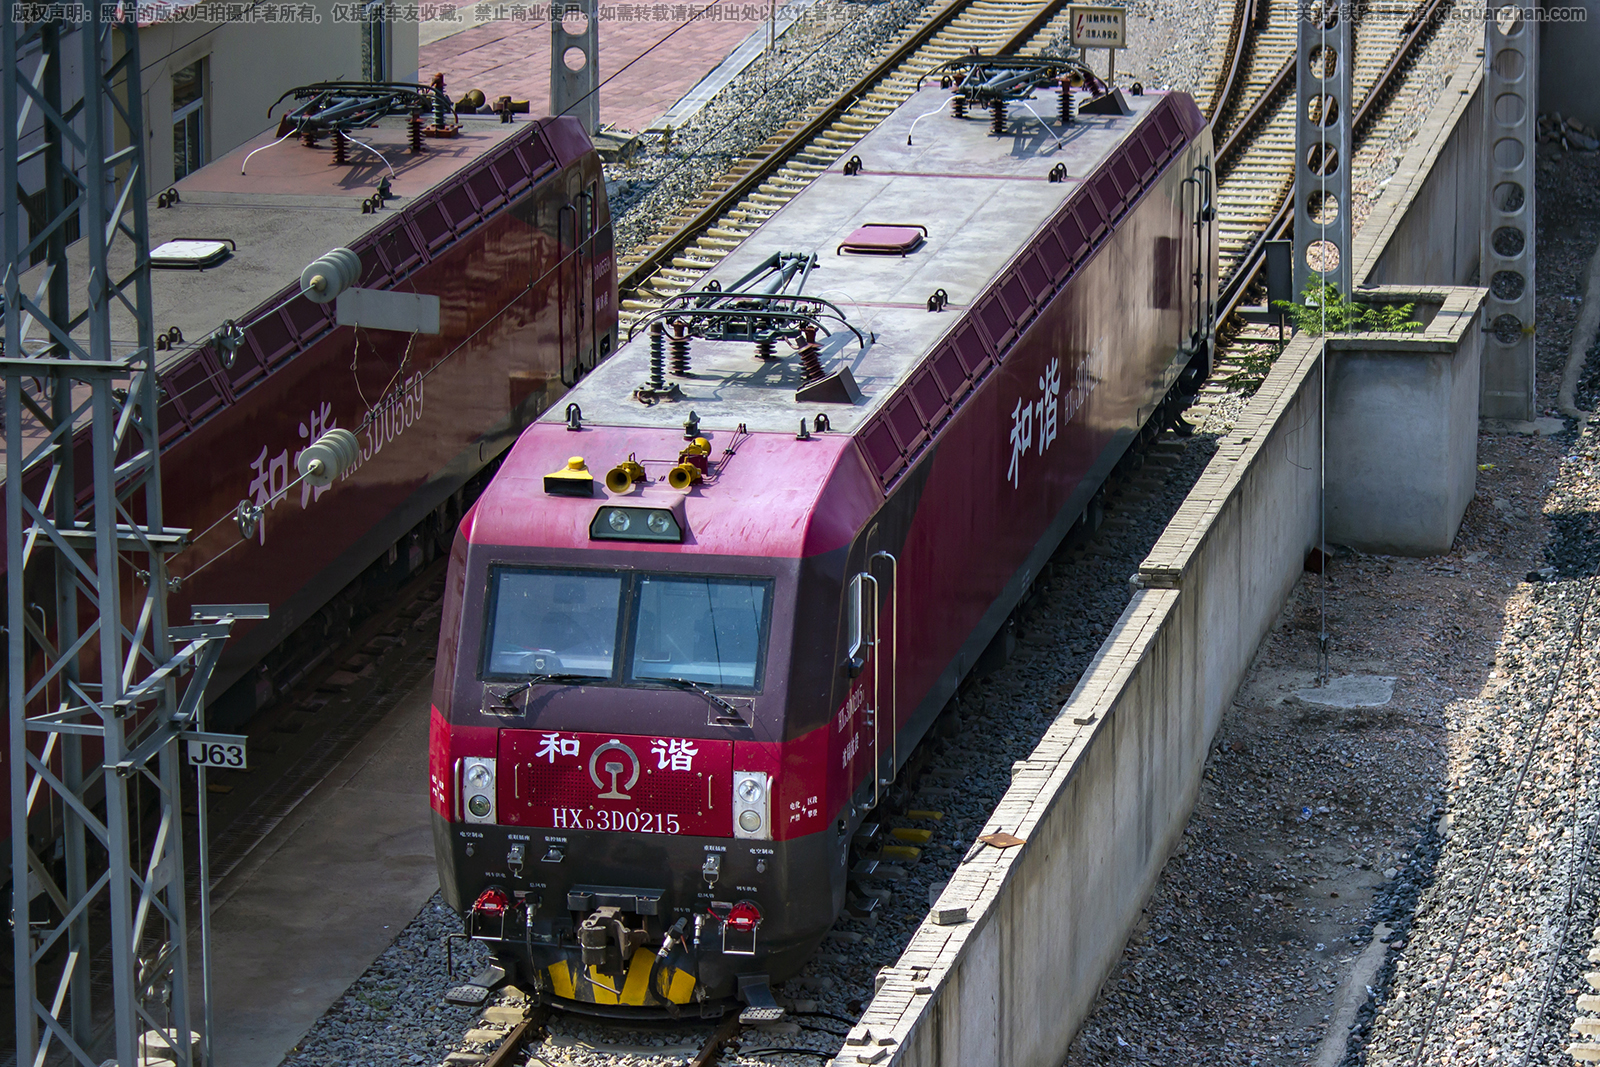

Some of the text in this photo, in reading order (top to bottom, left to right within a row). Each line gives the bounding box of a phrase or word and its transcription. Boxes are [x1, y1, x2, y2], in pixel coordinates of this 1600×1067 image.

[1007, 357, 1061, 489] 和谐
[191, 743, 244, 767] J63
[535, 732, 699, 772] 和 谐
[552, 807, 681, 834] HXD3D0215
